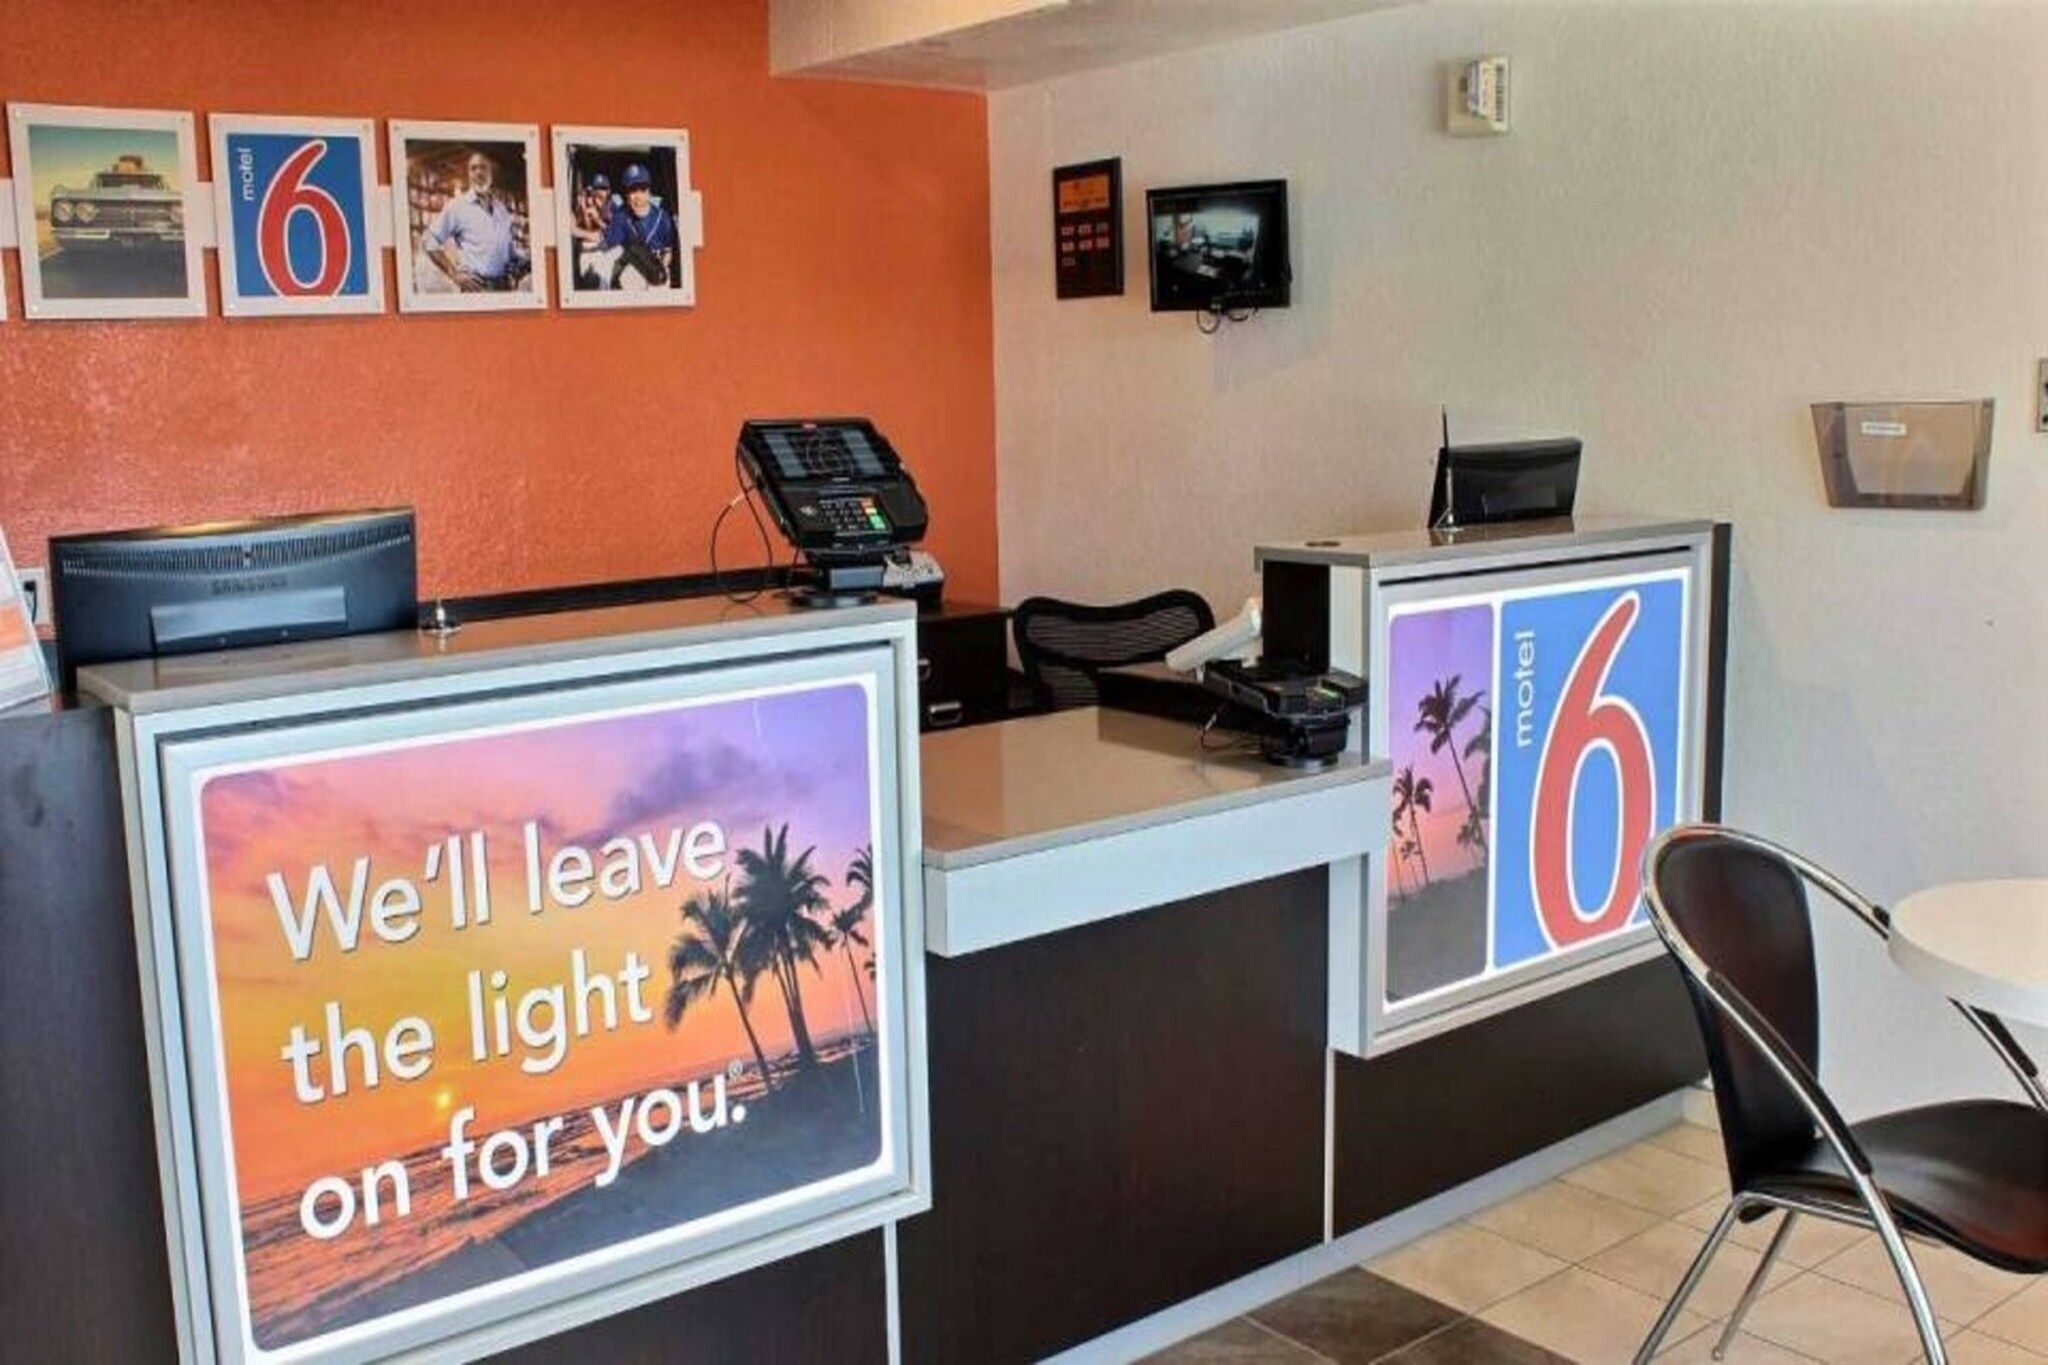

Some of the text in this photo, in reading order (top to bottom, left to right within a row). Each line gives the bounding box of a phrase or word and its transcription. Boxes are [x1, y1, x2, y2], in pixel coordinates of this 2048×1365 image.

[238, 139, 351, 298] motel 6
[1514, 590, 1657, 952] motel 6
[266, 820, 727, 961] We'll leave
[281, 948, 654, 1105] the light
[300, 1159, 411, 1239] on
[442, 1107, 564, 1200] for
